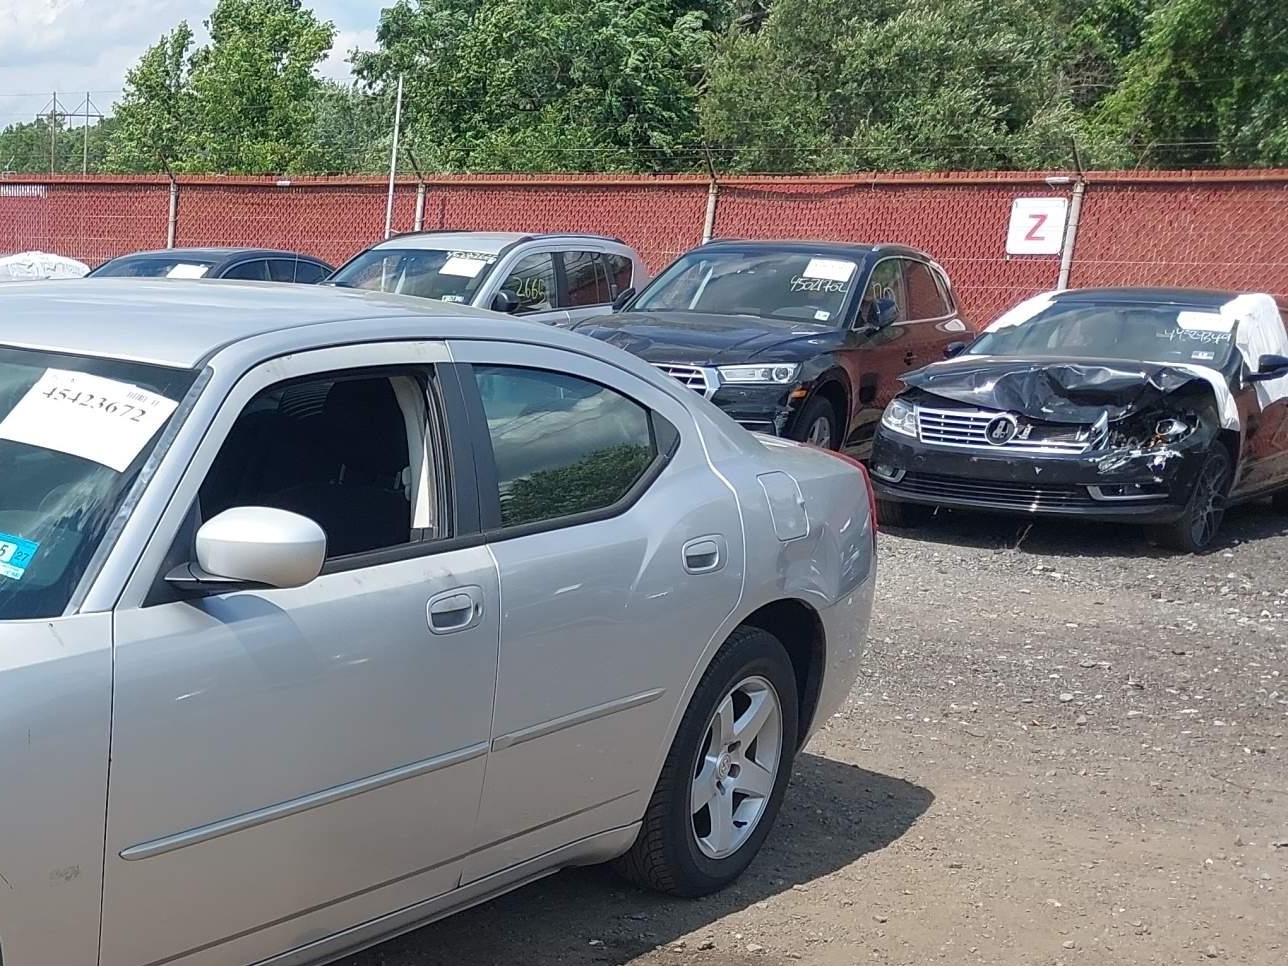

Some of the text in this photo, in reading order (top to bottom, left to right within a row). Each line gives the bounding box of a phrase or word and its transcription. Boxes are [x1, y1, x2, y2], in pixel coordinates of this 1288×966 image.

[1024, 214, 1049, 241] Z
[790, 275, 849, 293] 45021702
[42, 387, 147, 423] 45423672
[14, 551, 30, 562] 27
